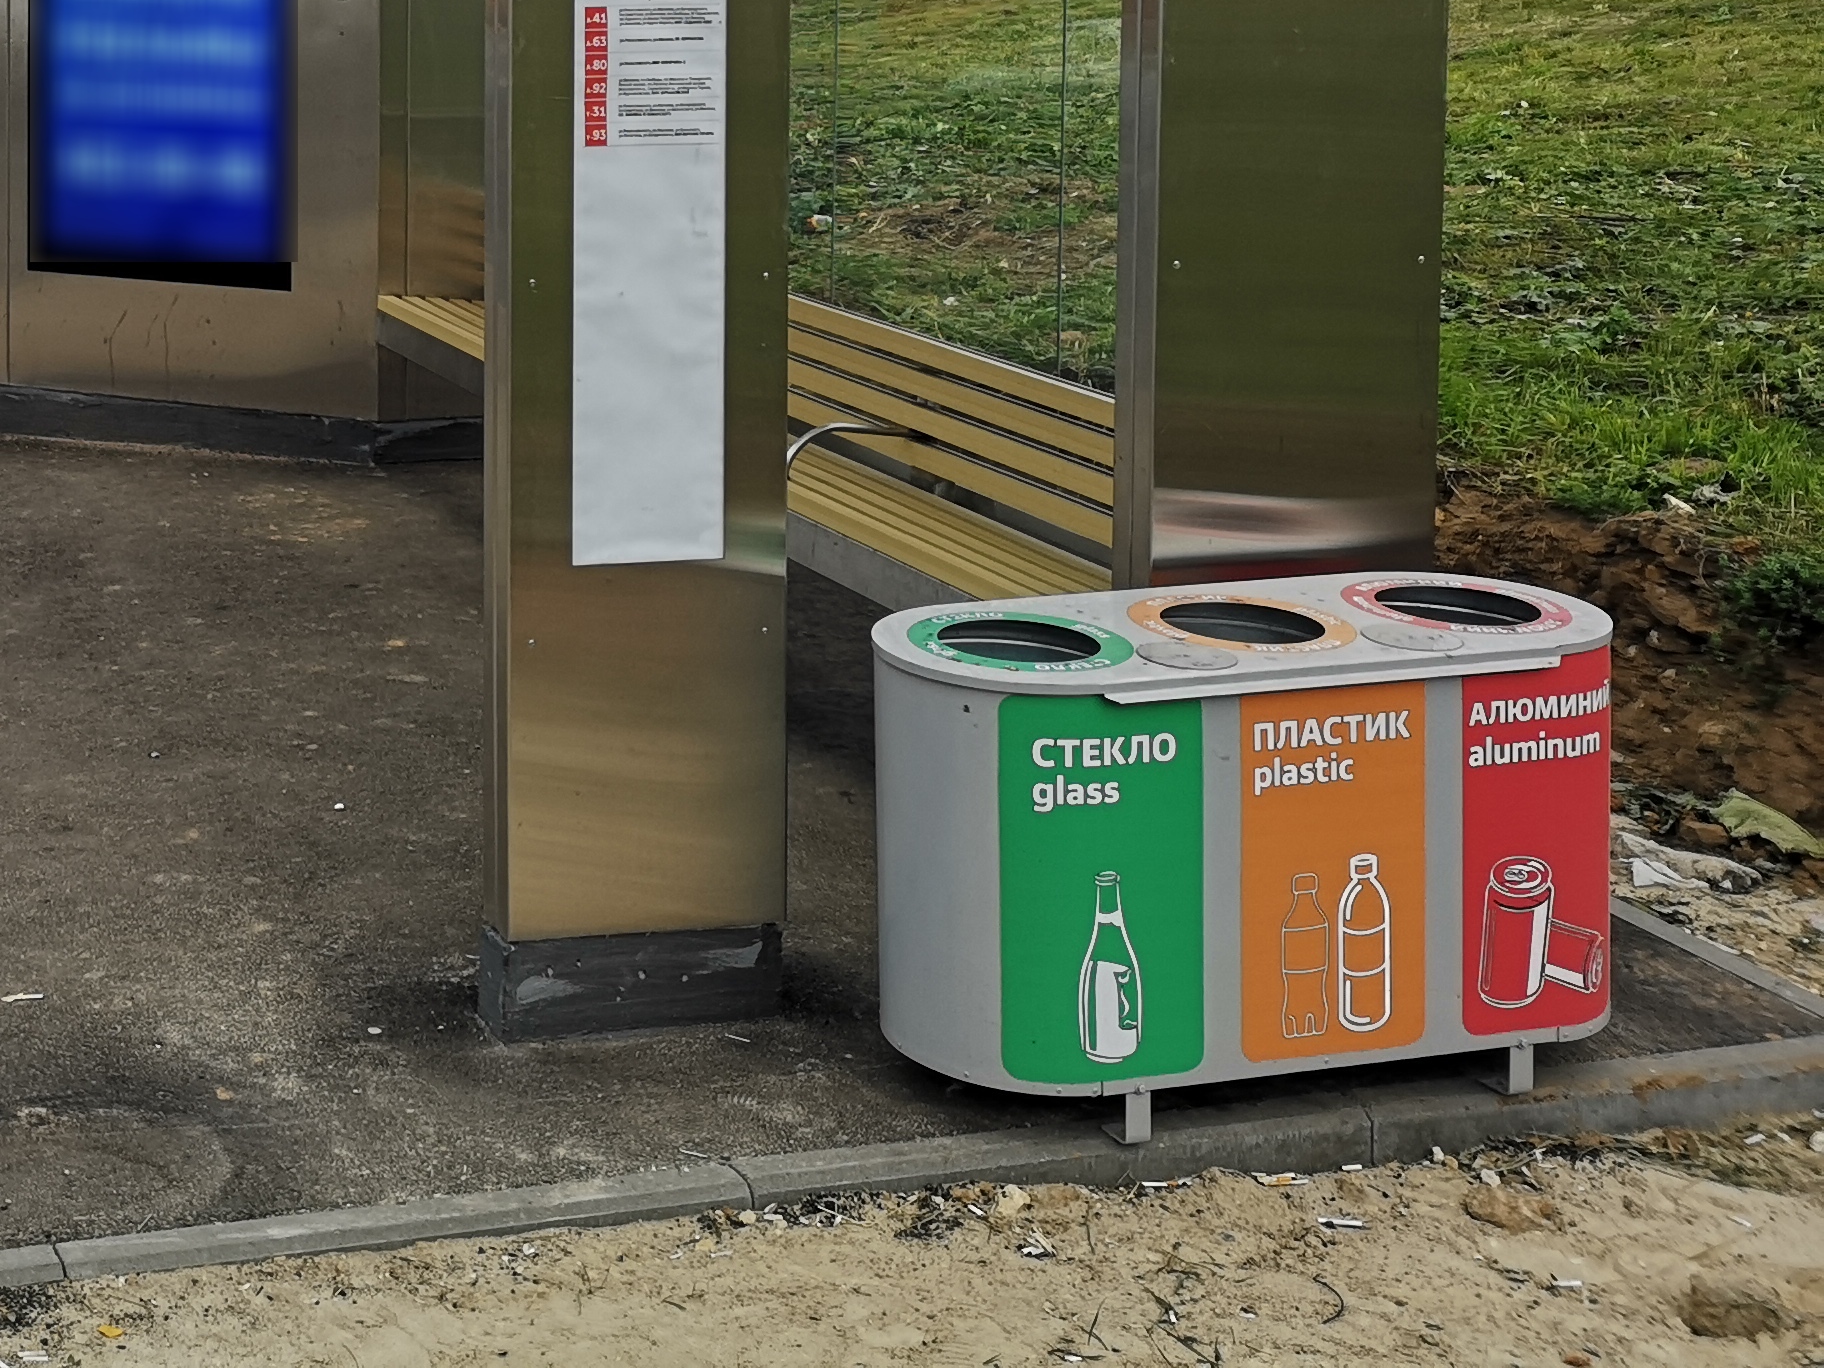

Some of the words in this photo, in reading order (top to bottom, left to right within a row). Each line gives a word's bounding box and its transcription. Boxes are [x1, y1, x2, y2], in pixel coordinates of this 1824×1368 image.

[1031, 731, 1178, 769] СТЕКЛО
[1253, 709, 1412, 753] ПЛАСТИК
[1468, 729, 1601, 768] aluminum
[1253, 751, 1355, 796] plastic
[1031, 774, 1121, 814] glass
